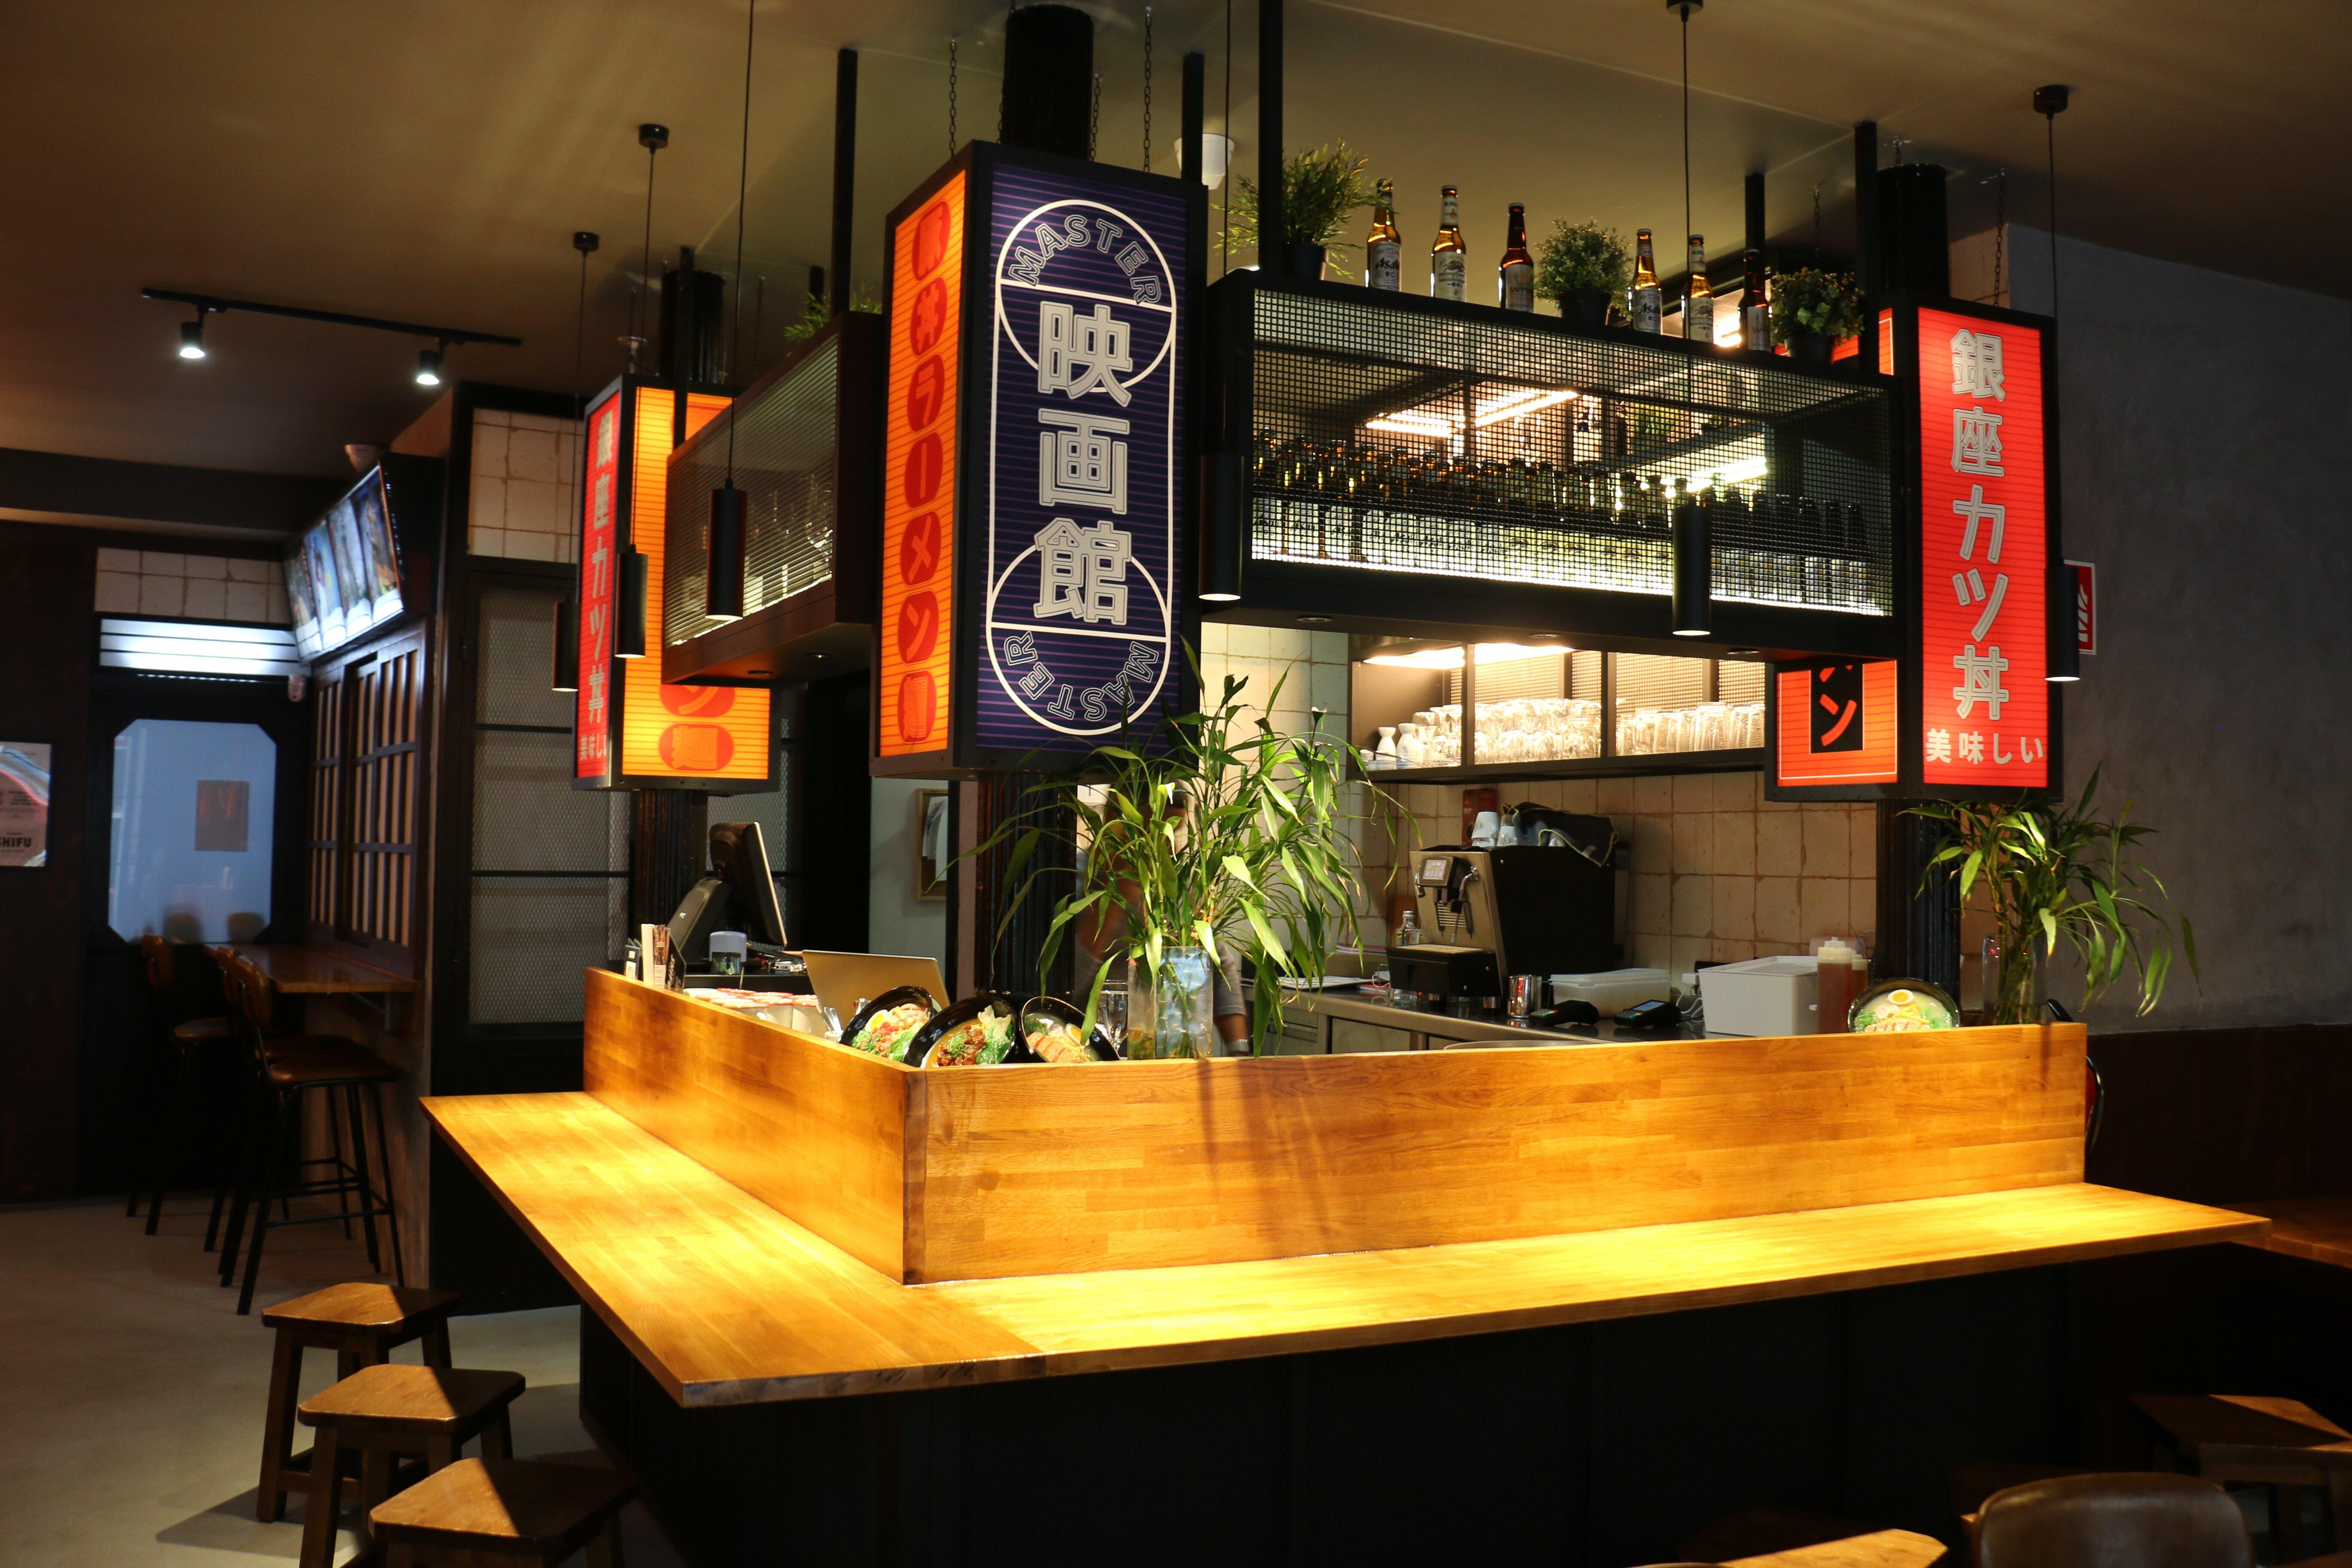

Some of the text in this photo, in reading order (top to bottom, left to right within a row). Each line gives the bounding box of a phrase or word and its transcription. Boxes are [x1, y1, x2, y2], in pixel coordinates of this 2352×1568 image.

[1008, 214, 1161, 306] MASTER
[1033, 300, 1133, 625] 映画館
[1950, 328, 2009, 721] 銀座カツ丼
[1004, 629, 1161, 721] MASTER
[1924, 727, 2044, 766] 美味しい
[0, 837, 32, 848] HIFU
